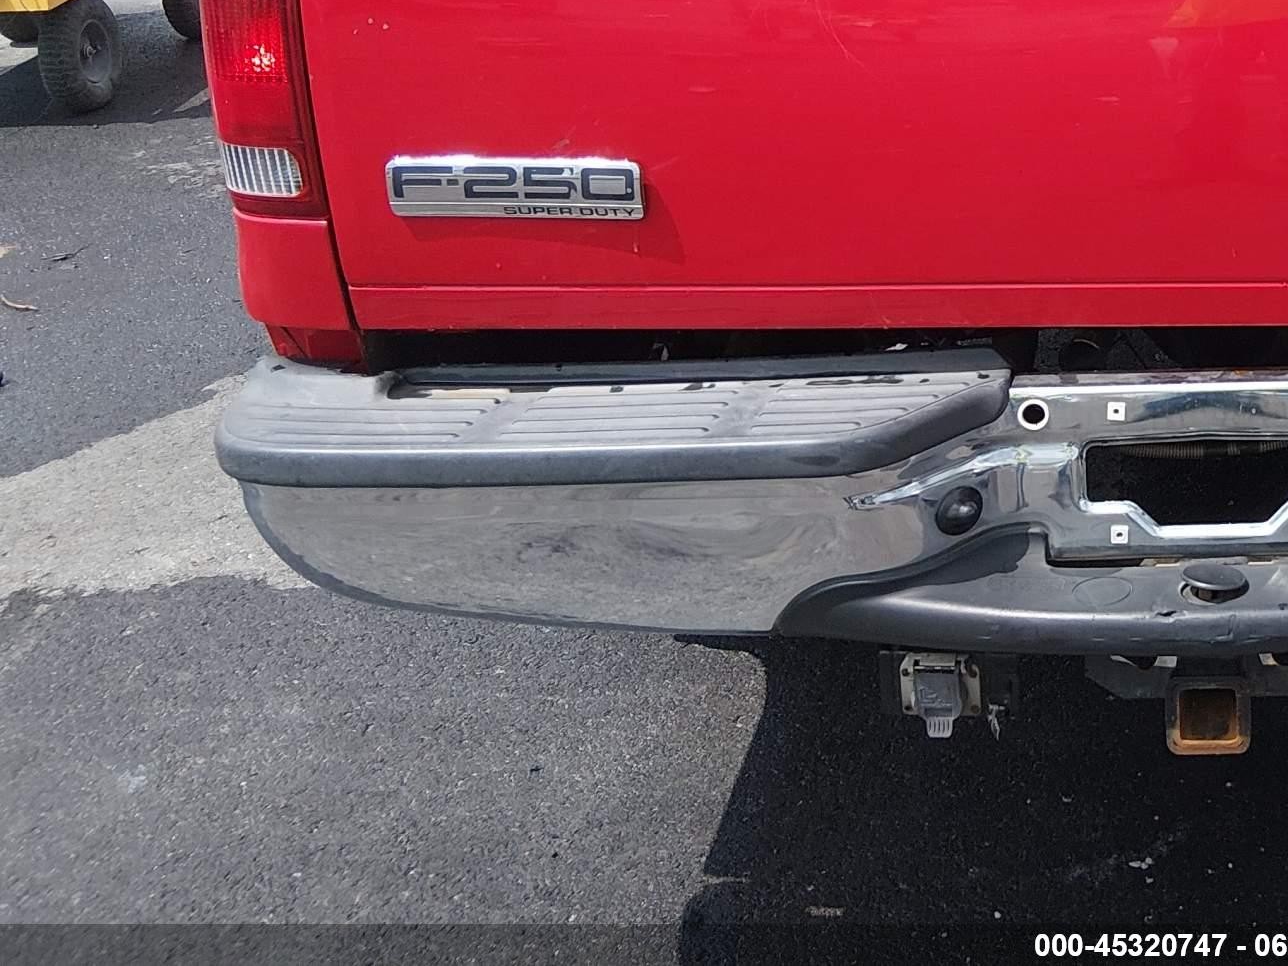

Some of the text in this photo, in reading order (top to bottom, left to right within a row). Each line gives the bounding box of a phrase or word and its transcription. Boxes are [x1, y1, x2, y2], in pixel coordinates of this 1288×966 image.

[391, 166, 635, 202] F-250
[503, 206, 635, 218] SUPER DUTY
